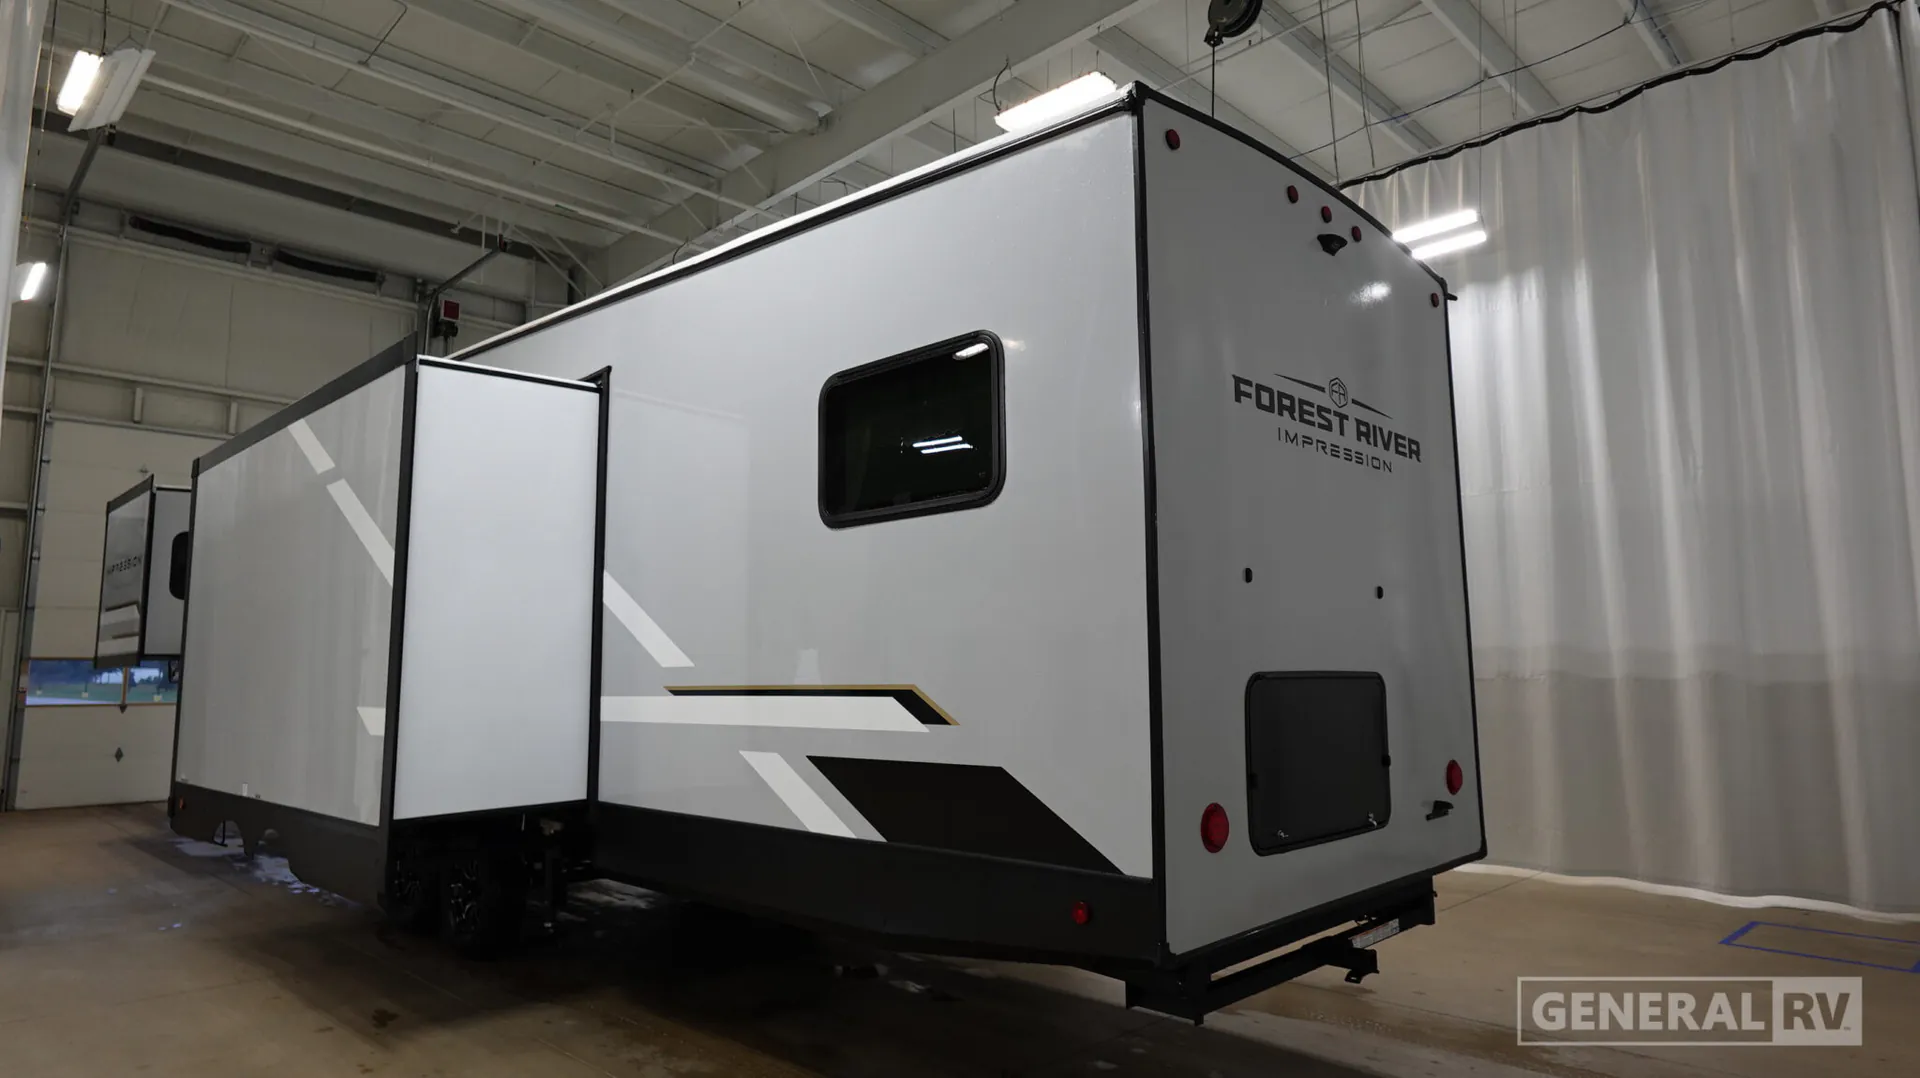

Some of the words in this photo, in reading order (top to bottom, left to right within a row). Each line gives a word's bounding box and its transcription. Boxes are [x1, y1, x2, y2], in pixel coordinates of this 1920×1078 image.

[1232, 374, 1349, 437] FOREST
[1354, 417, 1422, 463] RIVER
[1278, 427, 1393, 473] IMPRESSION
[107, 555, 142, 575] PRESSON
